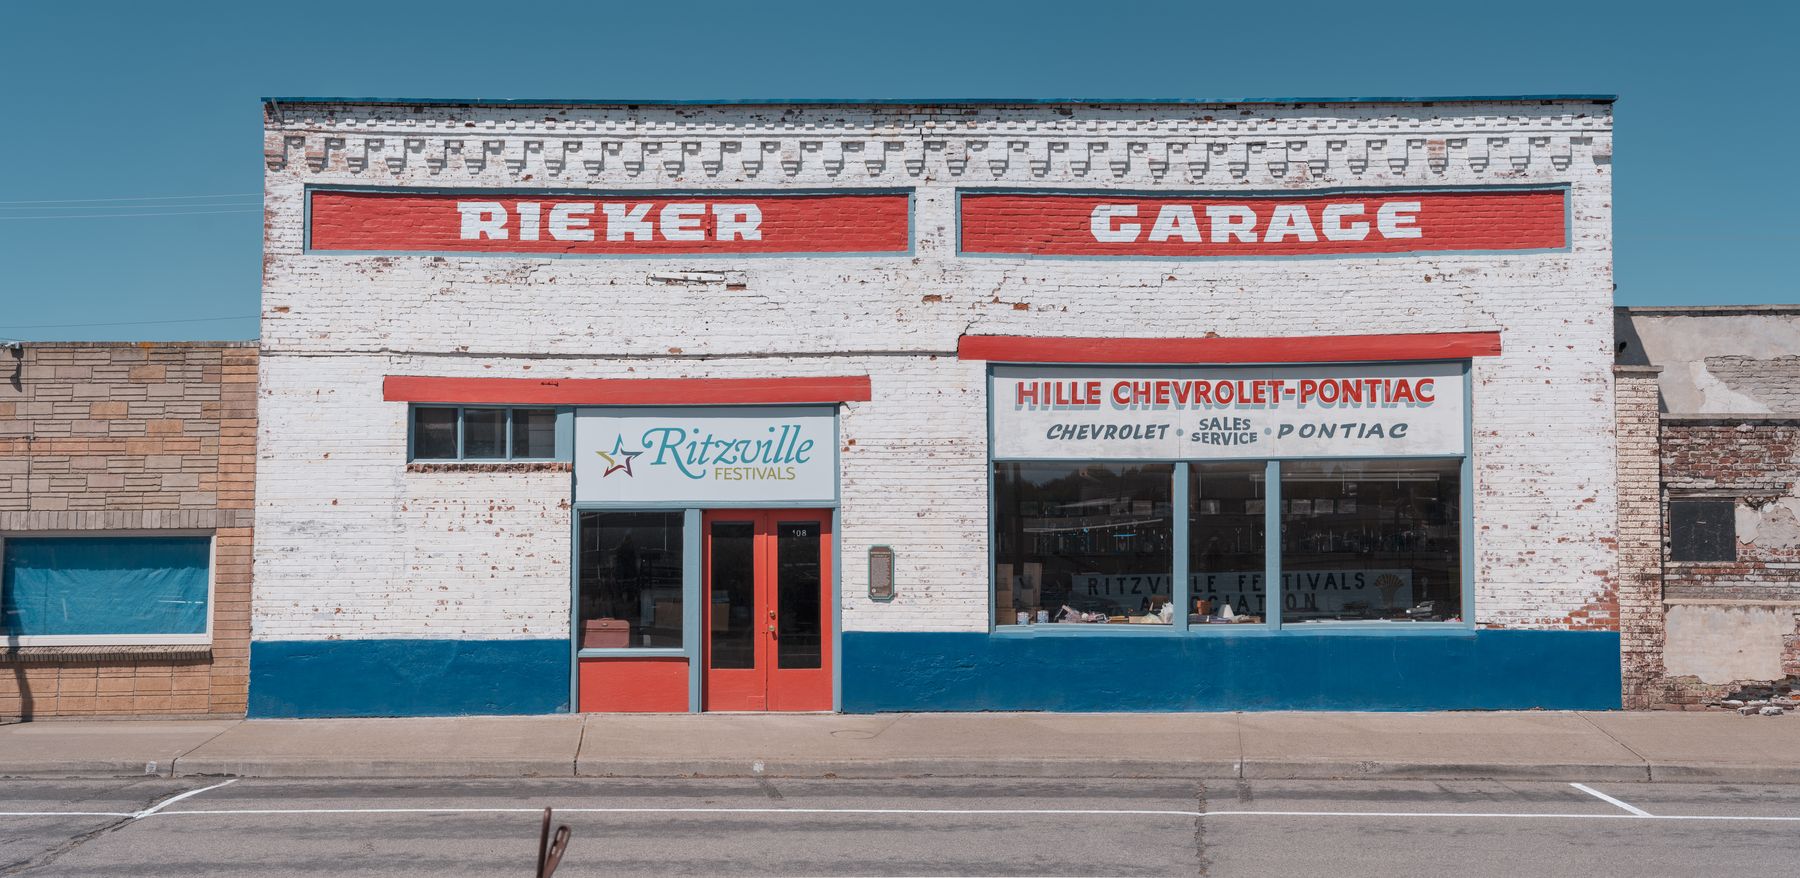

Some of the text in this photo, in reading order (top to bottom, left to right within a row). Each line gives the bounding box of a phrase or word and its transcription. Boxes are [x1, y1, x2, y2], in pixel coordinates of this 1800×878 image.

[457, 202, 762, 241] RIEKER
[1090, 202, 1422, 242] GARAGE
[1014, 378, 1435, 410] HILLE CHEVROLET-PONTIAC
[1047, 424, 1170, 440] CHEVROLET
[1199, 416, 1251, 431] SALES
[1277, 423, 1408, 439] PONTIAC
[1191, 431, 1258, 446] SERVICE
[641, 424, 814, 479] Ritzville
[715, 466, 796, 481] FESTIVALS
[1088, 572, 1365, 595] RITZVILE FETIVALS
